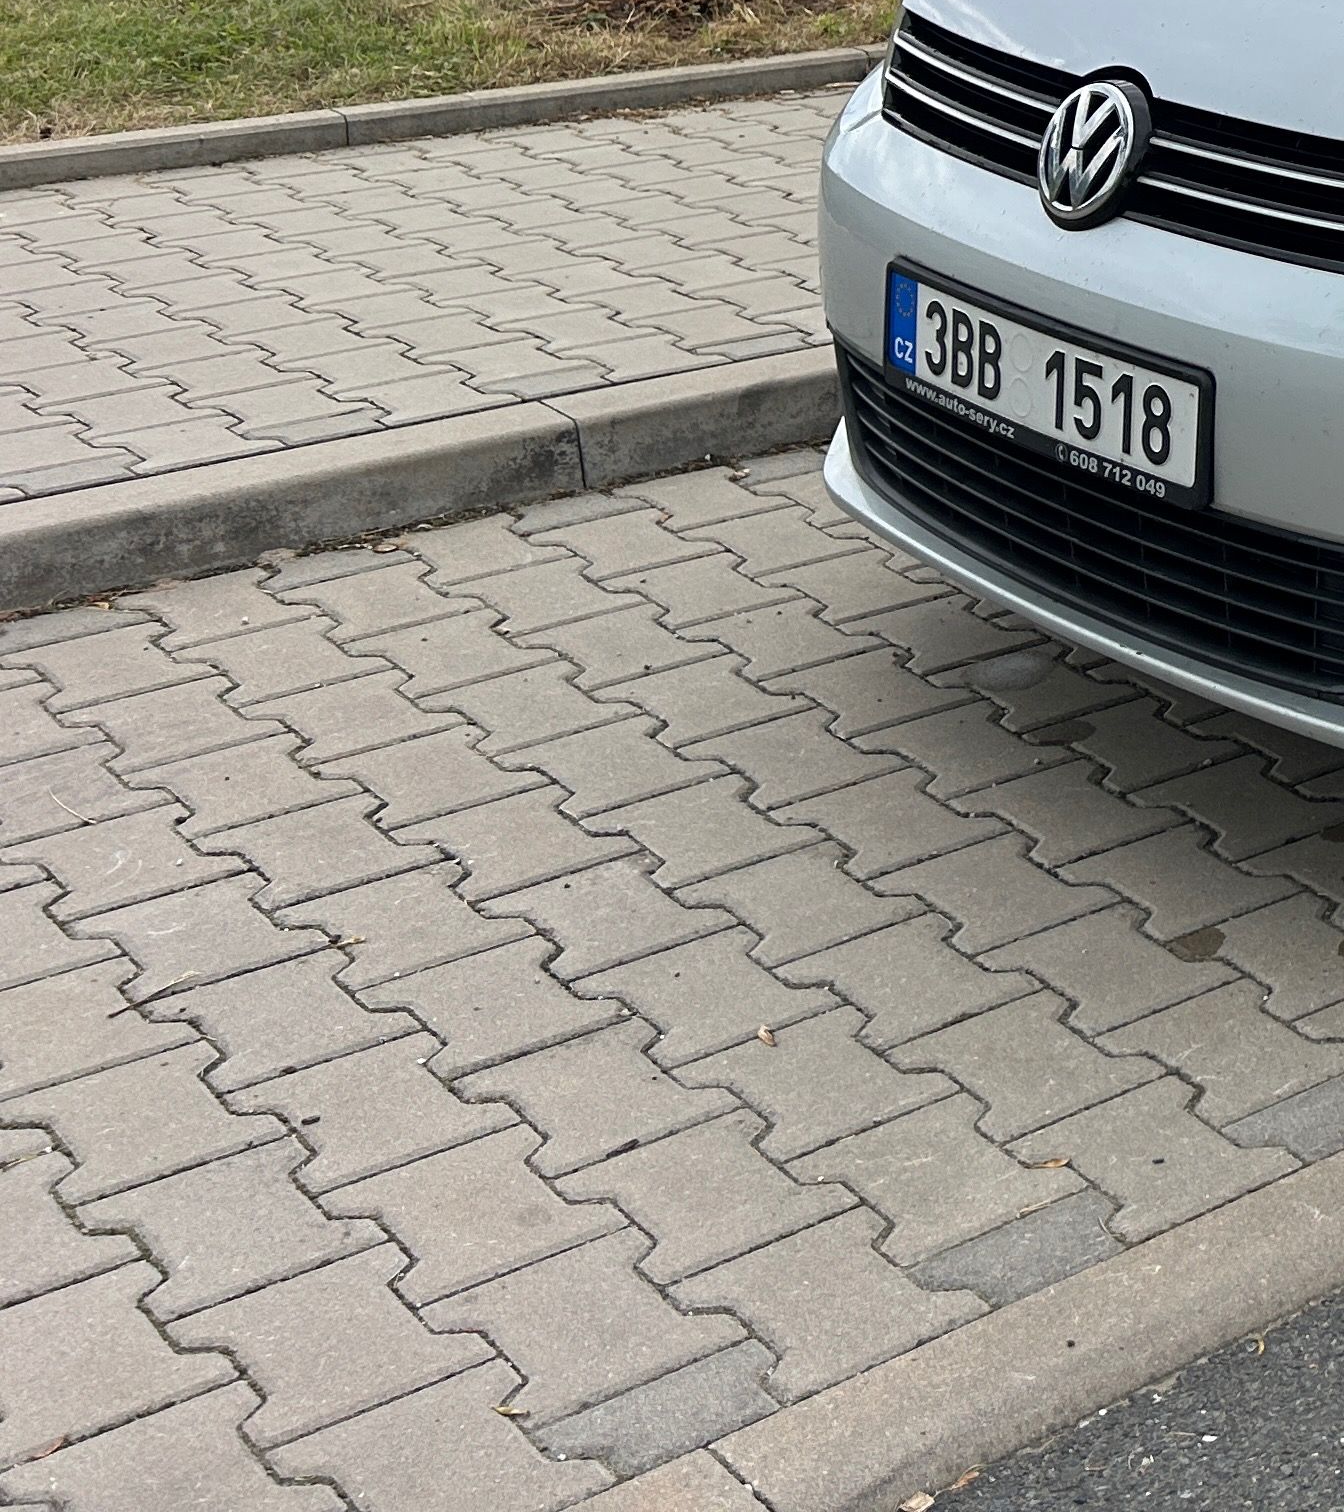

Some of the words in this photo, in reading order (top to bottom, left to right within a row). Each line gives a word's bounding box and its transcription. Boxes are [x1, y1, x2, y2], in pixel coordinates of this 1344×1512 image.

[1038, 81, 1135, 212] VW
[894, 336, 914, 364] CZ
[924, 299, 1003, 401] 3BB
[1044, 349, 1172, 466] 1518
[1069, 450, 1098, 473] 608
[1102, 461, 1132, 487] 712
[1136, 474, 1166, 499] 049
